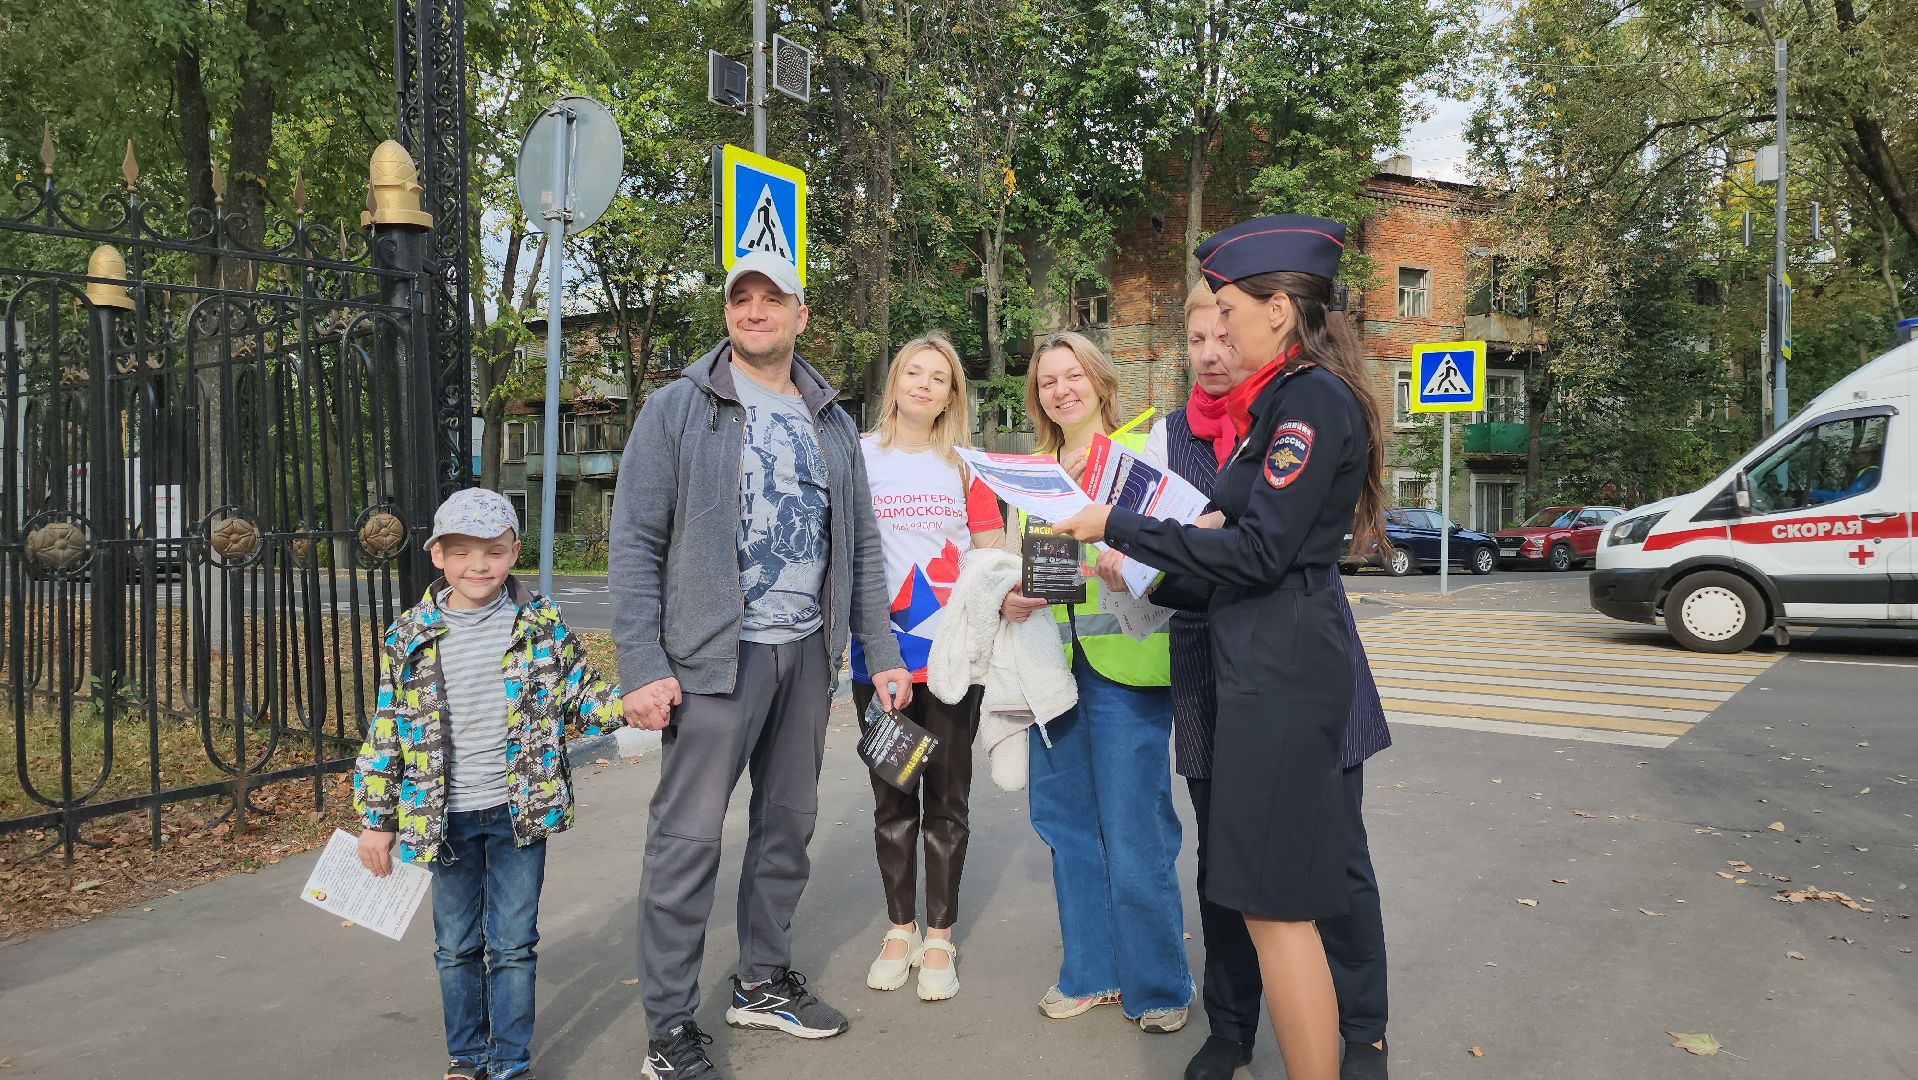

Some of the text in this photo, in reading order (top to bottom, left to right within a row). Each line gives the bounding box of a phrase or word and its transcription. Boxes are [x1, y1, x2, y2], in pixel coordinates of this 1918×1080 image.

[1275, 437, 1306, 451] РОССИЯ
[874, 506, 962, 518] ОДМОСКОВЬЯ
[1771, 521, 1863, 538] СКОРАЯ
